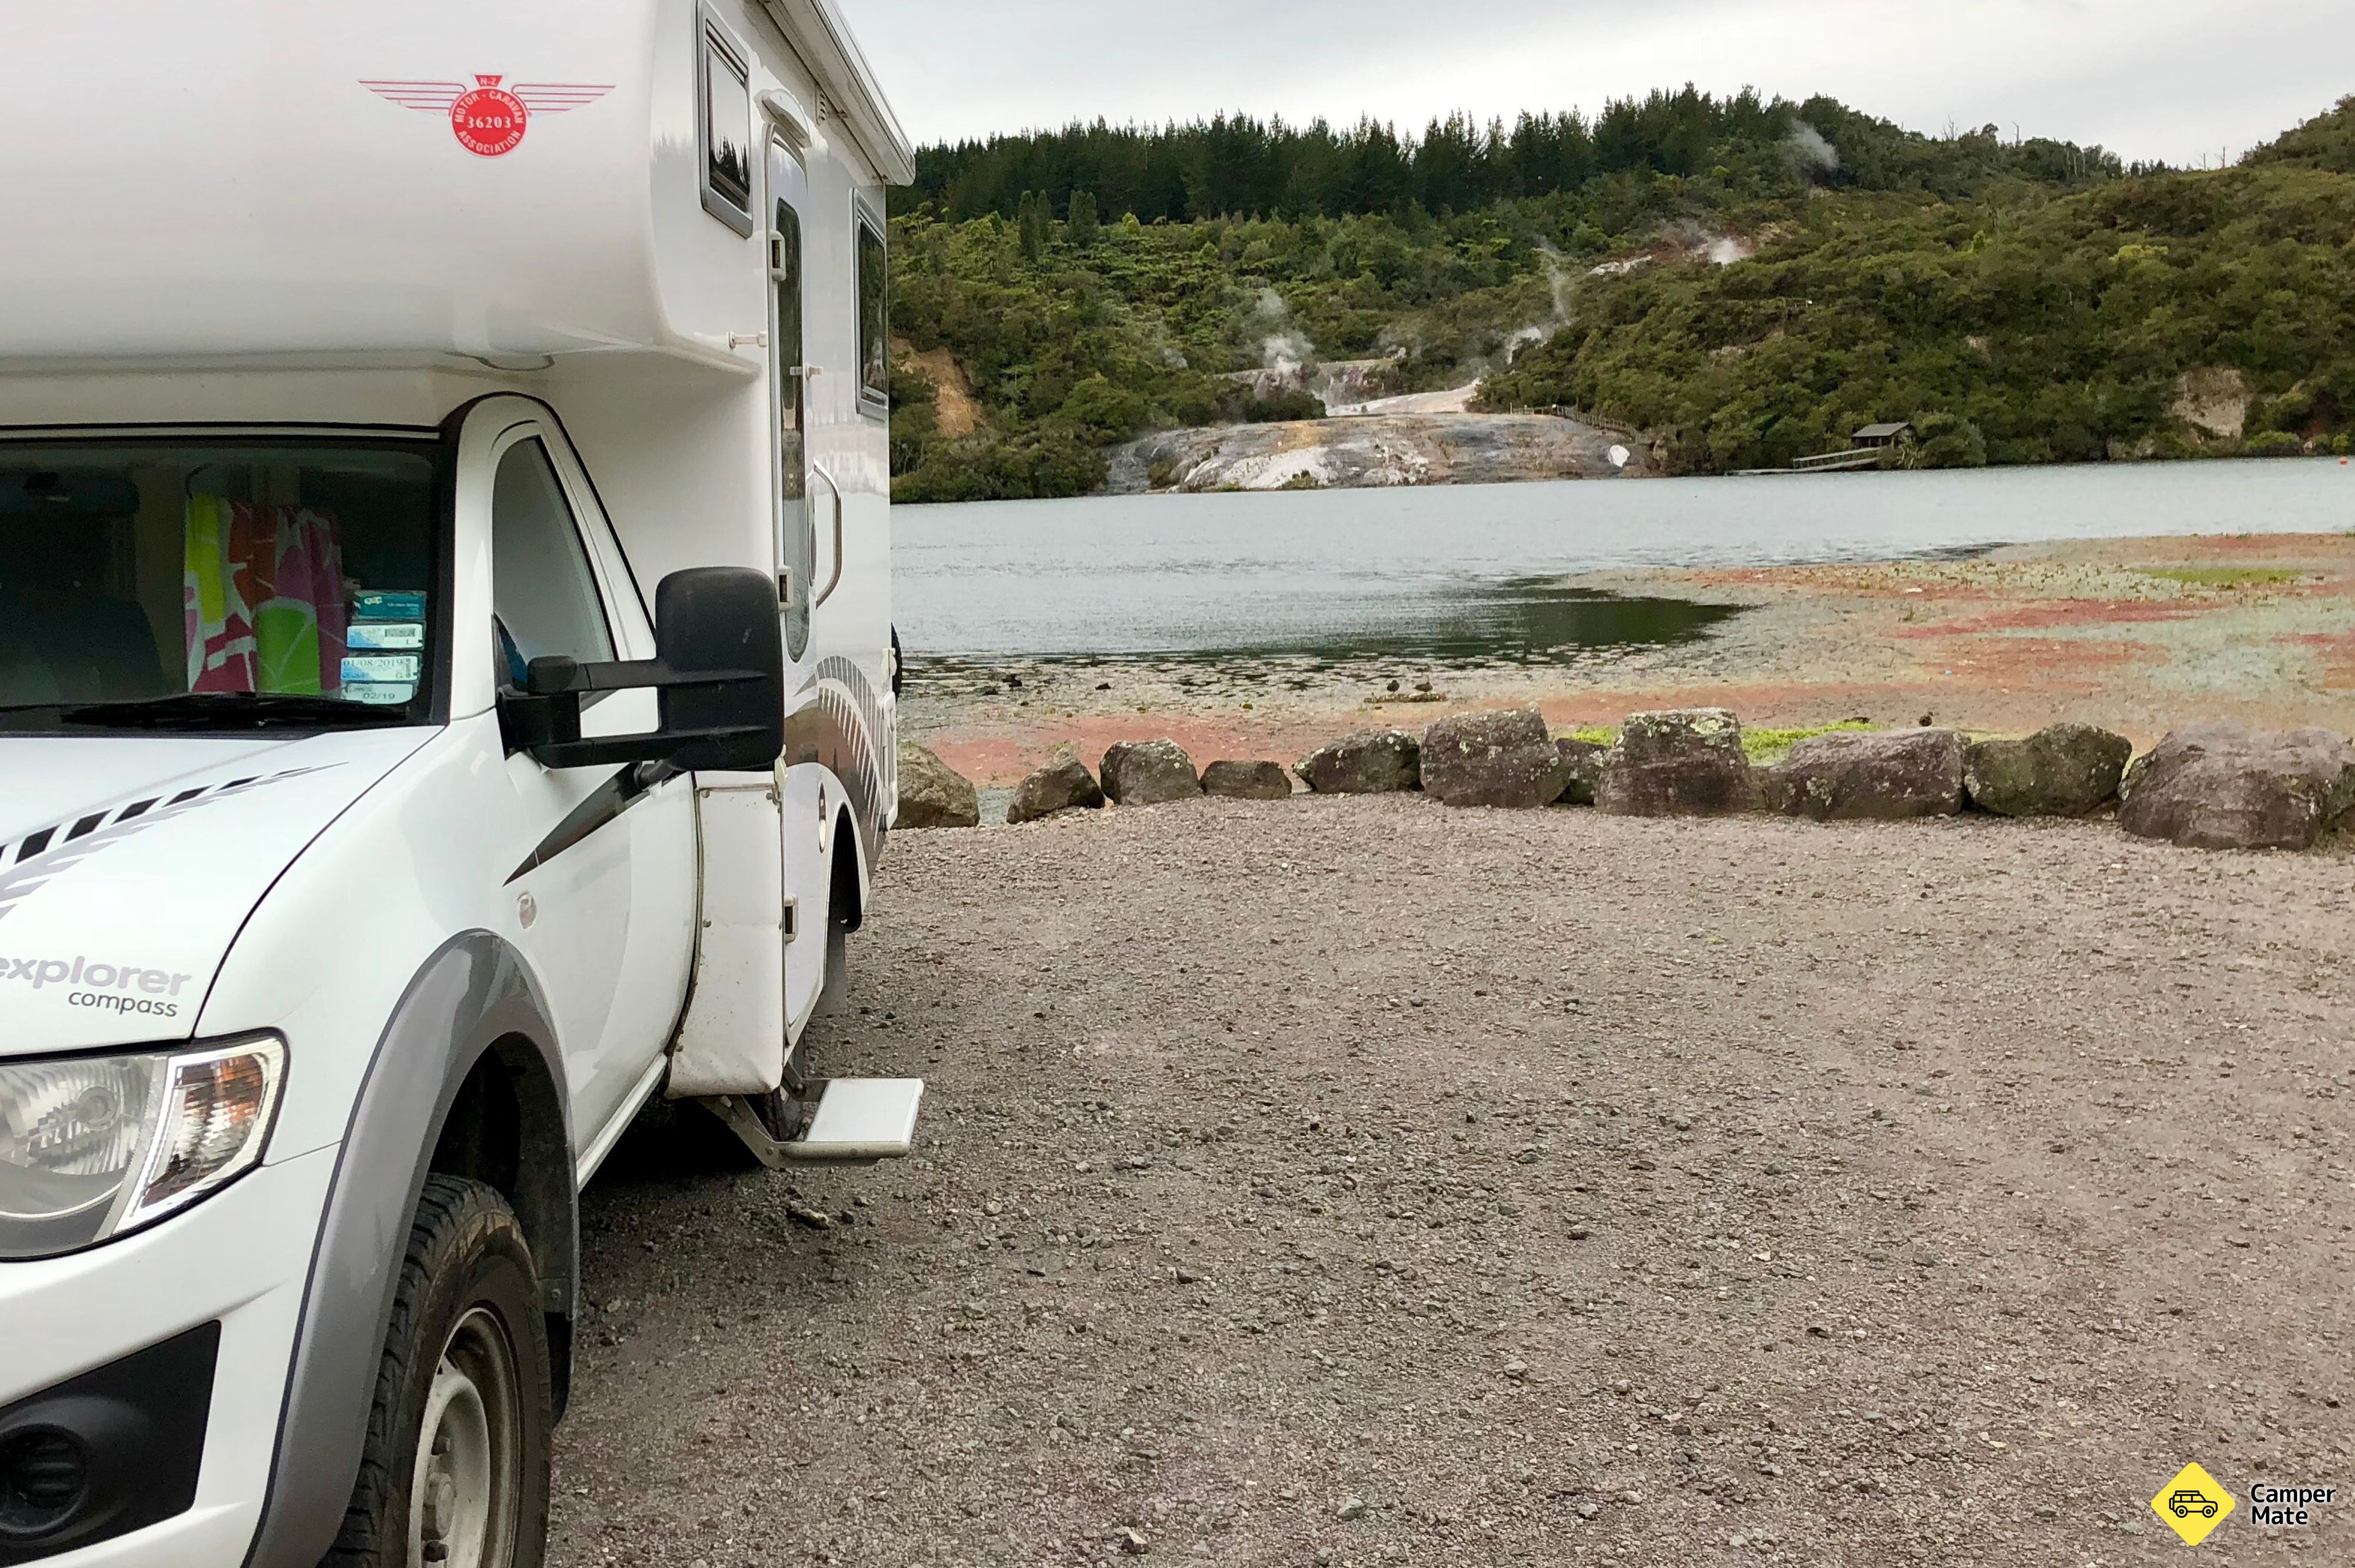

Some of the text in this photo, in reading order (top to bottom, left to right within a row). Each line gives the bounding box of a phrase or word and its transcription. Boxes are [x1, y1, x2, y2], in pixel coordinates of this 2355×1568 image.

[455, 90, 524, 124] MOTOR CARAVAN
[467, 116, 512, 129] 36203
[458, 131, 521, 154] ASSOCIATION
[68, 992, 178, 1017] compass
